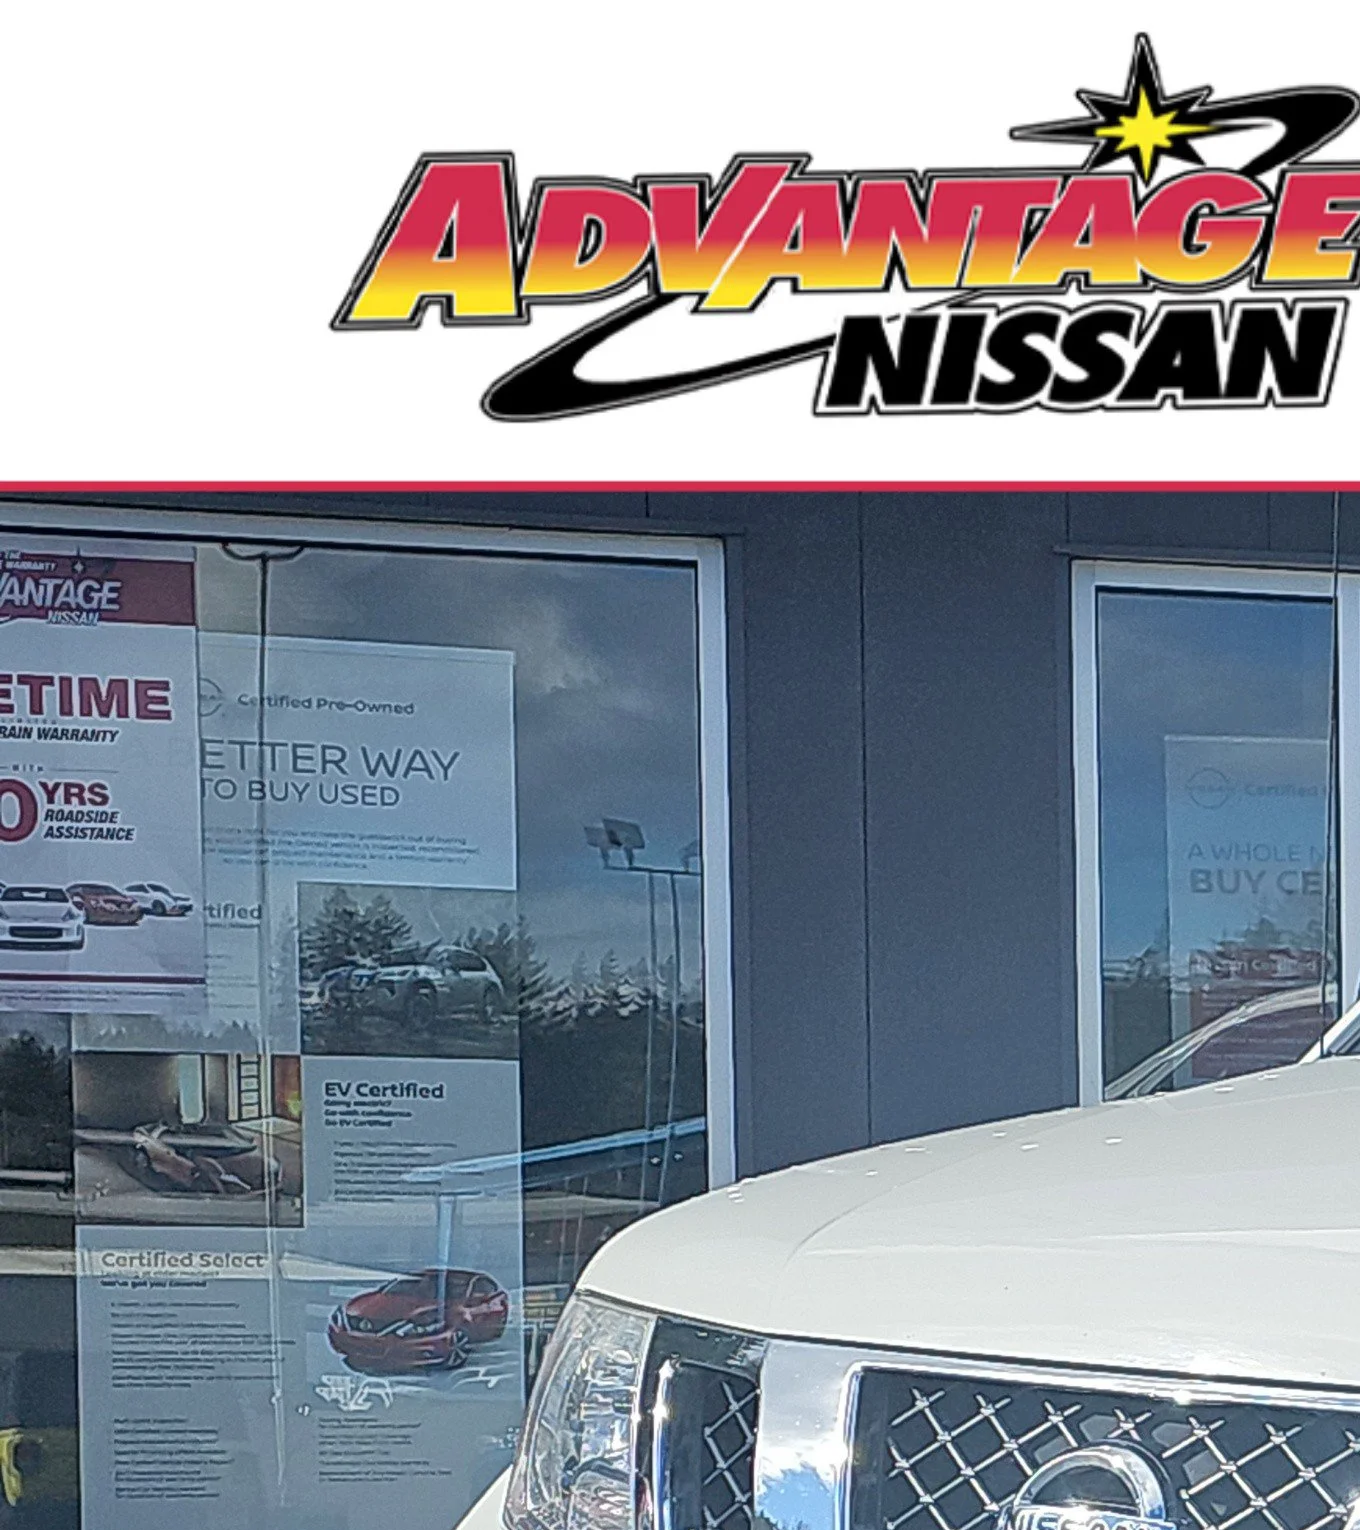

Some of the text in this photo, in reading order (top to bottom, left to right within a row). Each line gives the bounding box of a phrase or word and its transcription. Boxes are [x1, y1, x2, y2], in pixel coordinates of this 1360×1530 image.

[49, 610, 99, 626] NISSAN
[238, 694, 312, 710] Certified
[316, 698, 415, 715] Pre-Owned
[37, 727, 119, 742] WARRANTY
[361, 746, 460, 781] WAY
[38, 781, 110, 806] YRS
[249, 780, 310, 803] BUY
[319, 783, 400, 807] USED
[44, 809, 120, 824] ROADSIDE
[44, 826, 135, 841] ASSISTANCE
[1188, 844, 1204, 861] A
[1210, 844, 1299, 863] WHOLE
[1190, 868, 1266, 895] BUY
[325, 1082, 445, 1098] EV Certified
[101, 1252, 266, 1268] Certified Select
